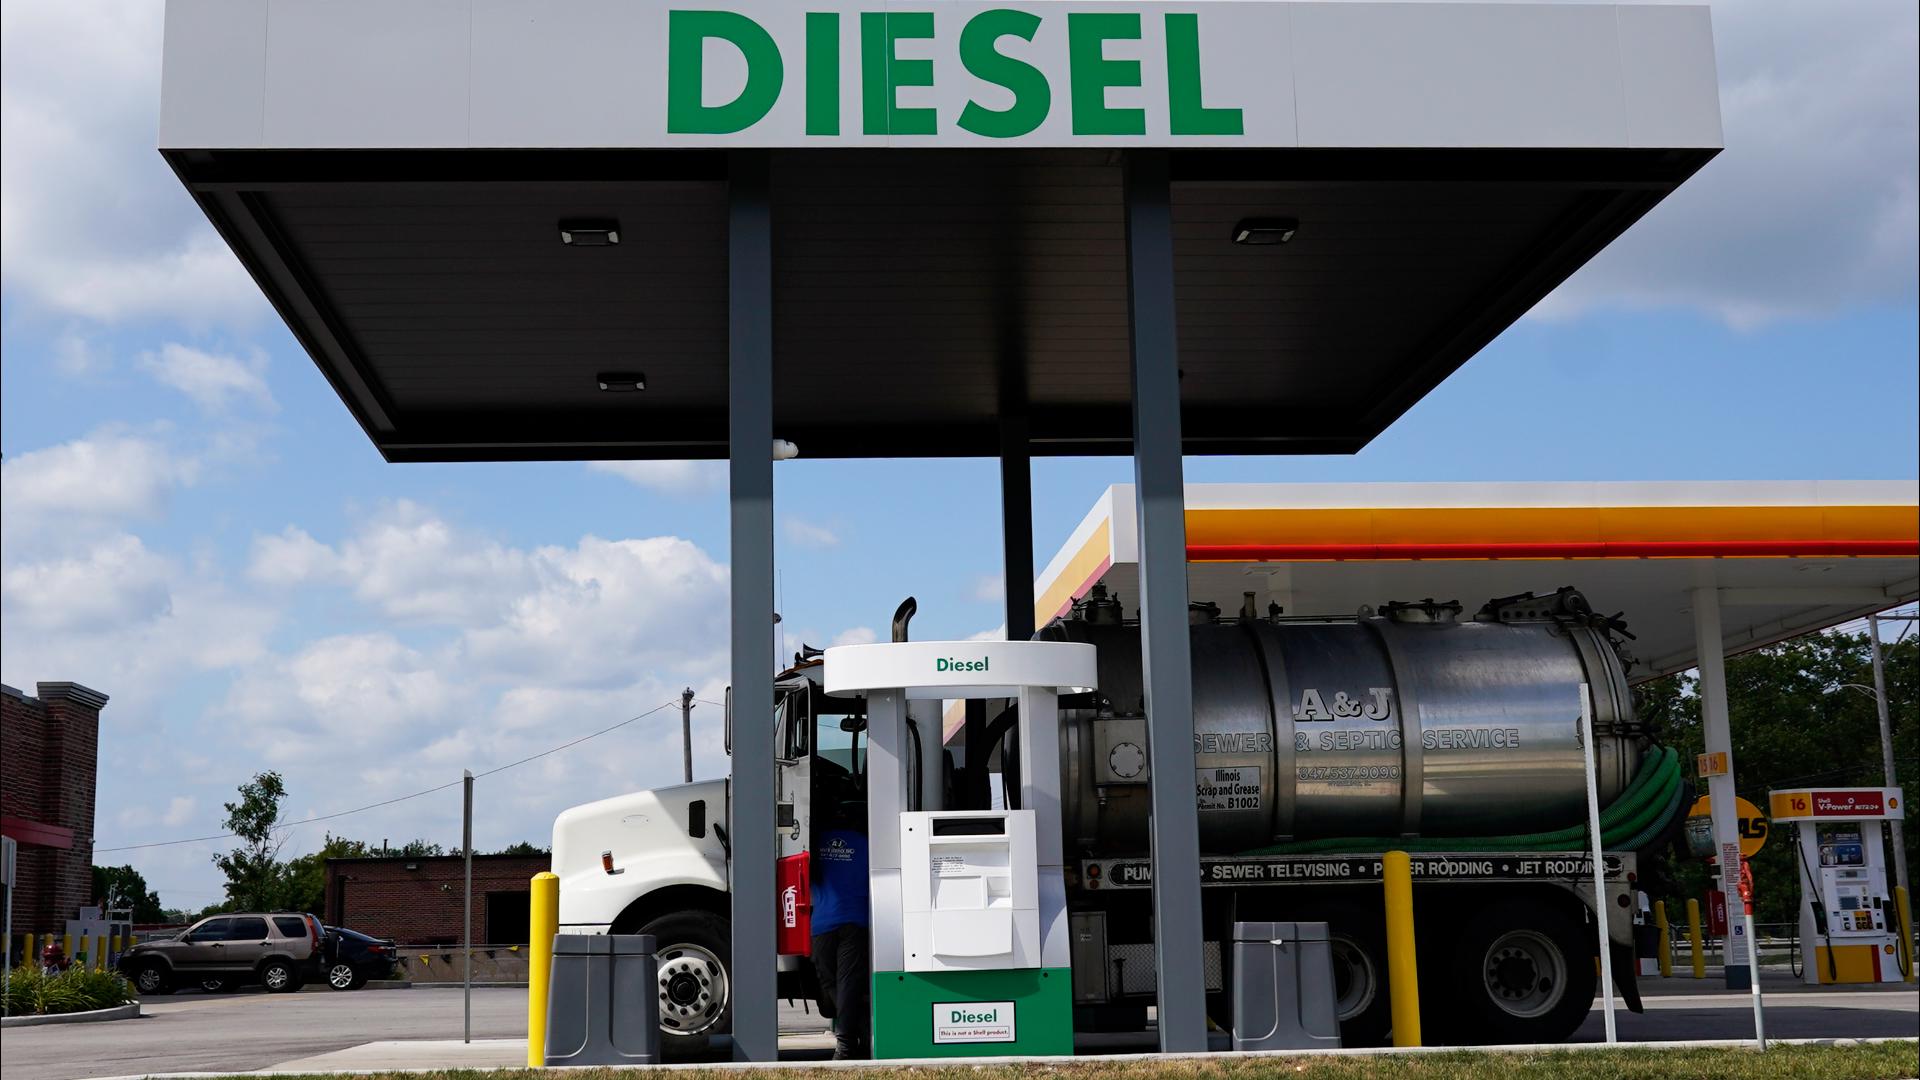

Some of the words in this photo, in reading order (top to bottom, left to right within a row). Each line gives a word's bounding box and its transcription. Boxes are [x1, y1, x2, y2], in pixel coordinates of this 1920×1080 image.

[667, 8, 1244, 139] DIESEL
[936, 656, 989, 672] Diesel
[1293, 687, 1393, 722] A&J
[1295, 731, 1311, 752] &
[1319, 729, 1401, 751] SEPTIC
[1422, 728, 1520, 750] SERVICE
[1215, 769, 1241, 782] Illinois
[1299, 766, 1400, 780] 847.537.9090
[1196, 784, 1218, 798] Scrap
[1218, 783, 1233, 795] and
[1234, 784, 1260, 795] Grease
[1227, 797, 1259, 809] B1002
[1790, 798, 1806, 811] 16
[1738, 818, 1768, 839] AS
[1212, 865, 1264, 880] SEWER
[1267, 863, 1351, 878] TELEVISING
[1428, 860, 1493, 876] RODDING
[1515, 861, 1542, 875] JET
[786, 897, 794, 924] FIRE
[951, 1008, 997, 1023] Diesel
